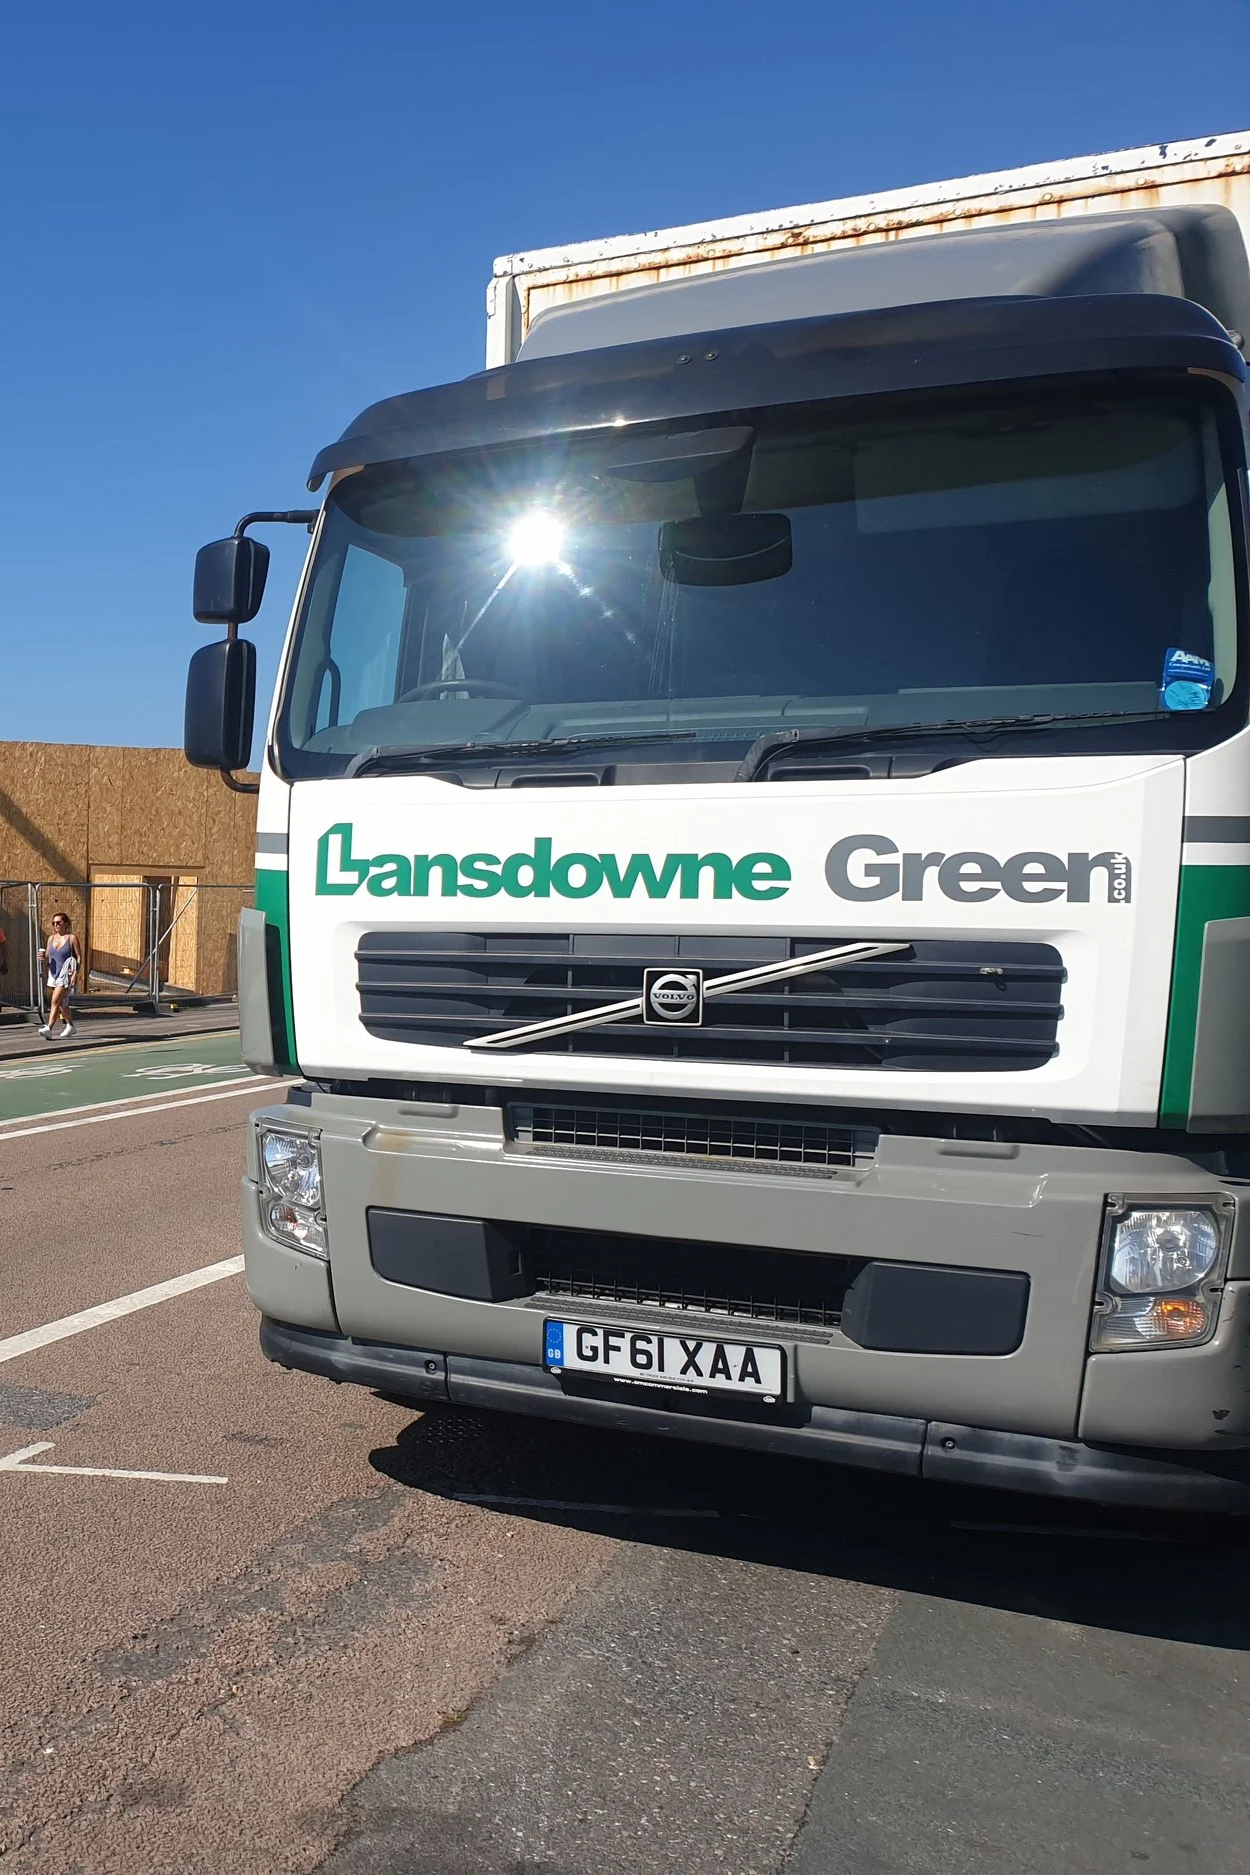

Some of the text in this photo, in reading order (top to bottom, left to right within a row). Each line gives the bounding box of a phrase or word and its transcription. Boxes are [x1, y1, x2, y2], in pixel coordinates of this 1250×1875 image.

[315, 822, 1132, 904] Lansdowne Green
[1110, 852, 1127, 904] .co.uk
[652, 993, 695, 1001] VOLVO
[547, 1348, 561, 1359] GB
[576, 1326, 762, 1385] GF61 XAA
